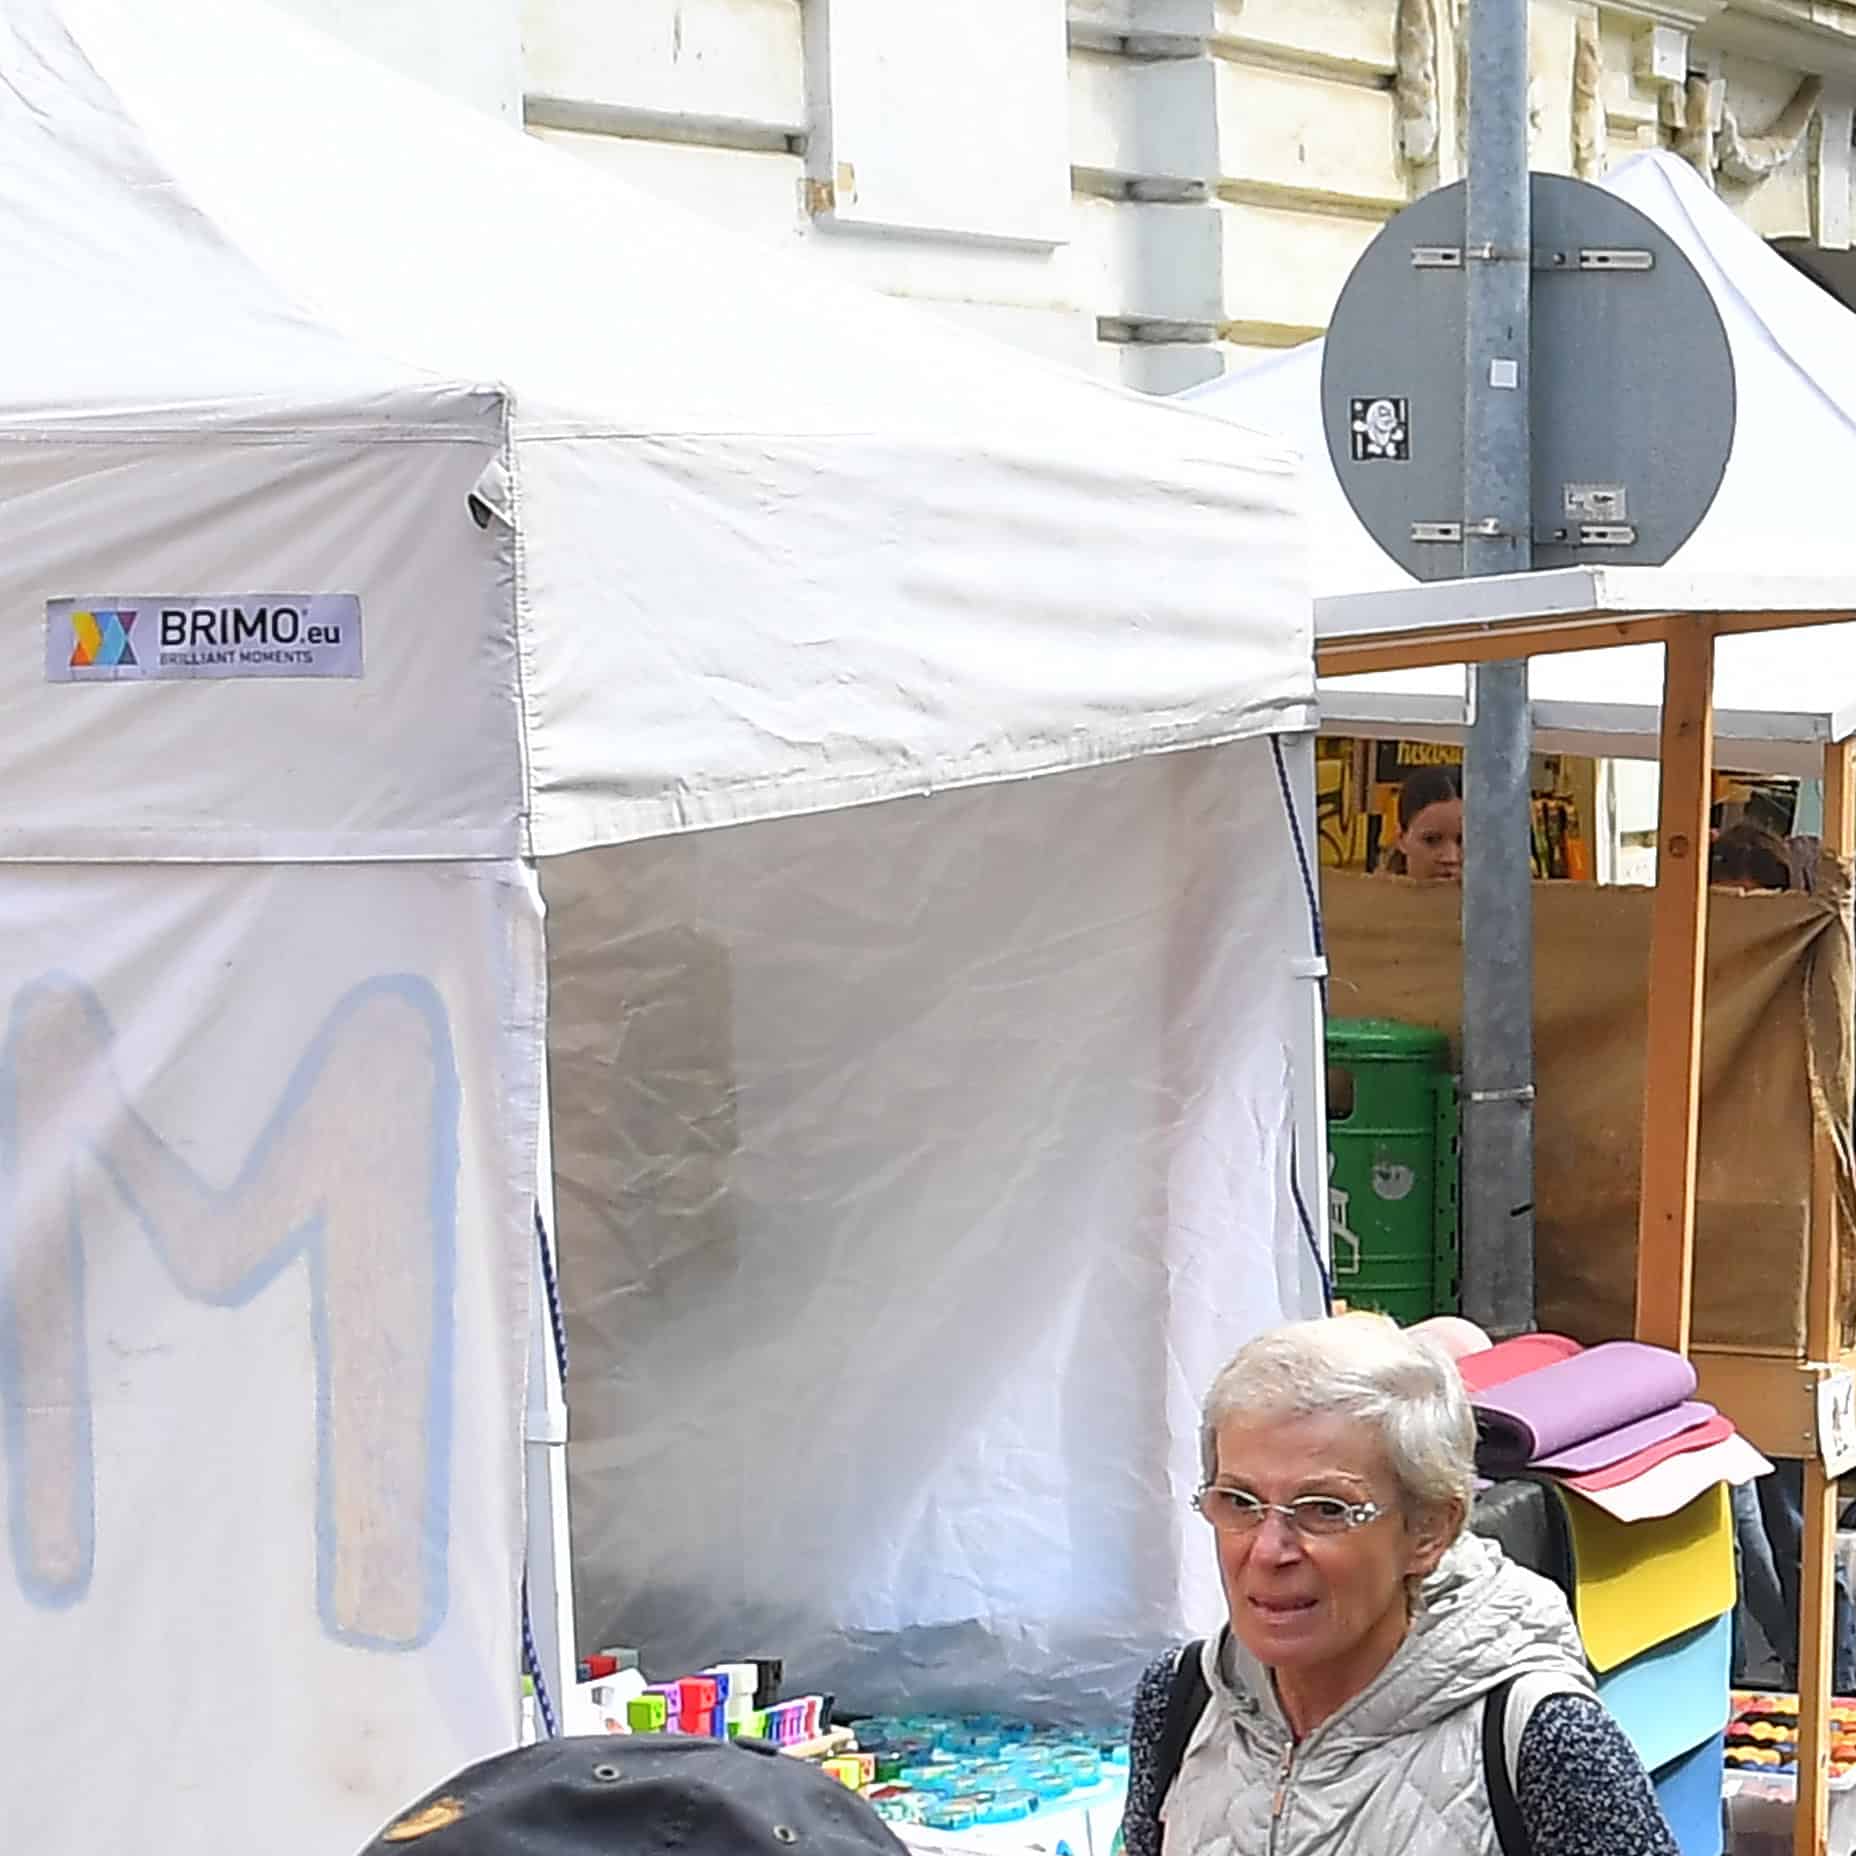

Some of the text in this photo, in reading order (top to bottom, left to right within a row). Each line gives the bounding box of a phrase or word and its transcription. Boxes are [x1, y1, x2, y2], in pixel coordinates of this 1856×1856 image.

[160, 606, 341, 647] BRIMO.eu
[160, 650, 313, 666] BRILLIANT MOMENTS
[0, 969, 464, 1652] M
